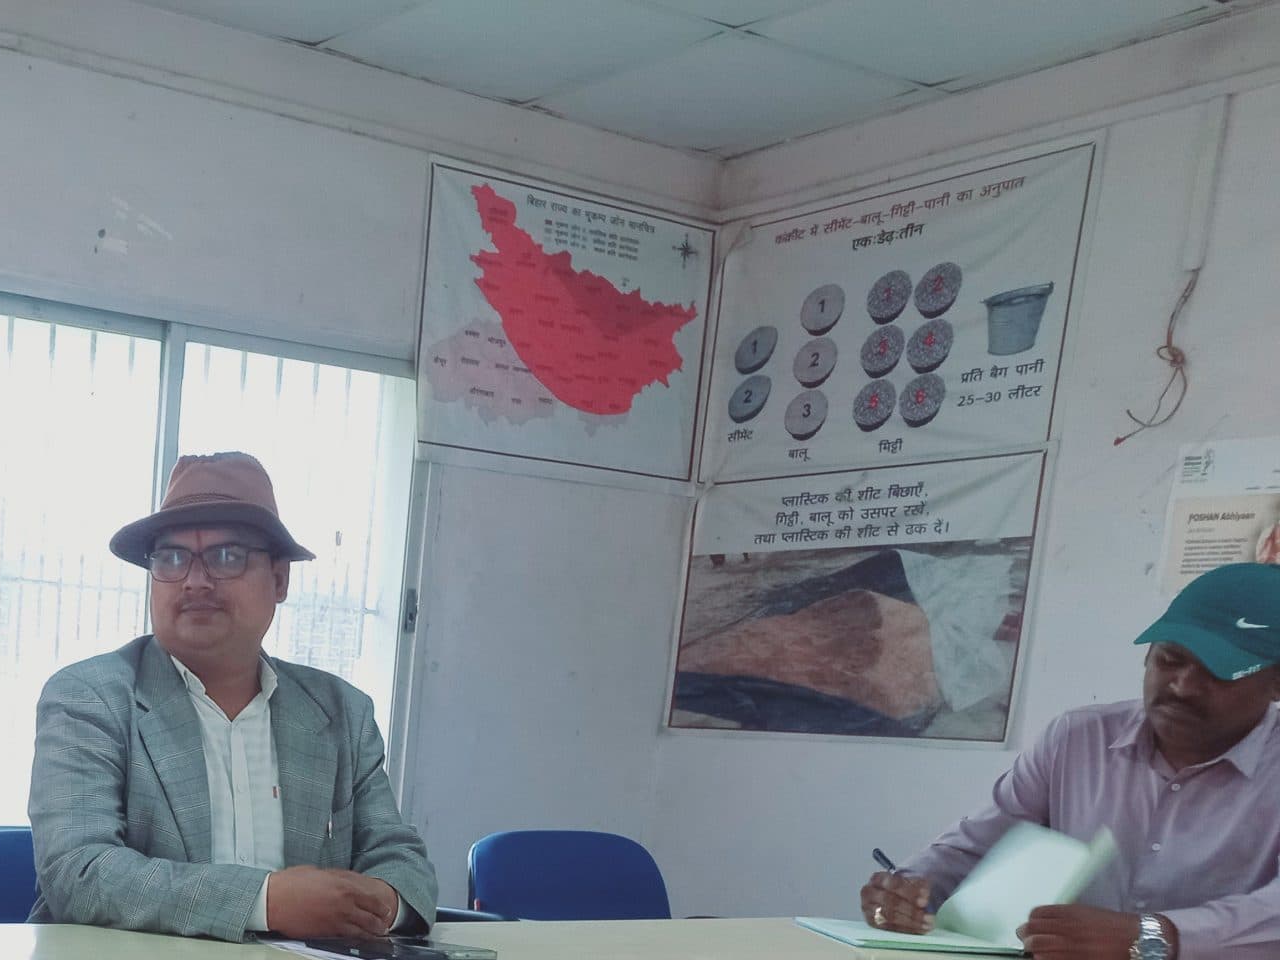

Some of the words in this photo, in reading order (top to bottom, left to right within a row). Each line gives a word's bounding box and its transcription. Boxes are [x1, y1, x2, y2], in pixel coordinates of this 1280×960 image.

[526, 194, 548, 209] बिहार
[572, 207, 582, 217] का
[810, 223, 820, 236] में
[956, 188, 975, 202] का
[979, 175, 1026, 198] अनुपात
[933, 275, 944, 292] 2
[818, 299, 825, 313] 1
[751, 339, 759, 354] 1
[810, 352, 820, 367] 2
[961, 367, 984, 384] प्रति
[990, 364, 1009, 379] बैग
[1016, 358, 1046, 376] पानी
[743, 390, 753, 403] 2
[1008, 384, 1043, 400] लीटर
[802, 403, 811, 418] 3
[727, 429, 754, 443] सीमेंट
[788, 448, 812, 462] बालू
[781, 491, 829, 507] प्लास्टिक
[835, 487, 853, 503] की
[857, 486, 882, 501] शीट
[809, 511, 835, 527] बालू
[838, 506, 854, 521] को
[860, 505, 898, 519] उसपर
[1187, 512, 1219, 525] POSHAN
[754, 532, 776, 545] तथा
[781, 528, 829, 543] प्लास्टिक
[835, 525, 852, 540] की
[857, 524, 881, 538] शीट
[886, 521, 900, 536] से
[904, 523, 928, 535] ढक
